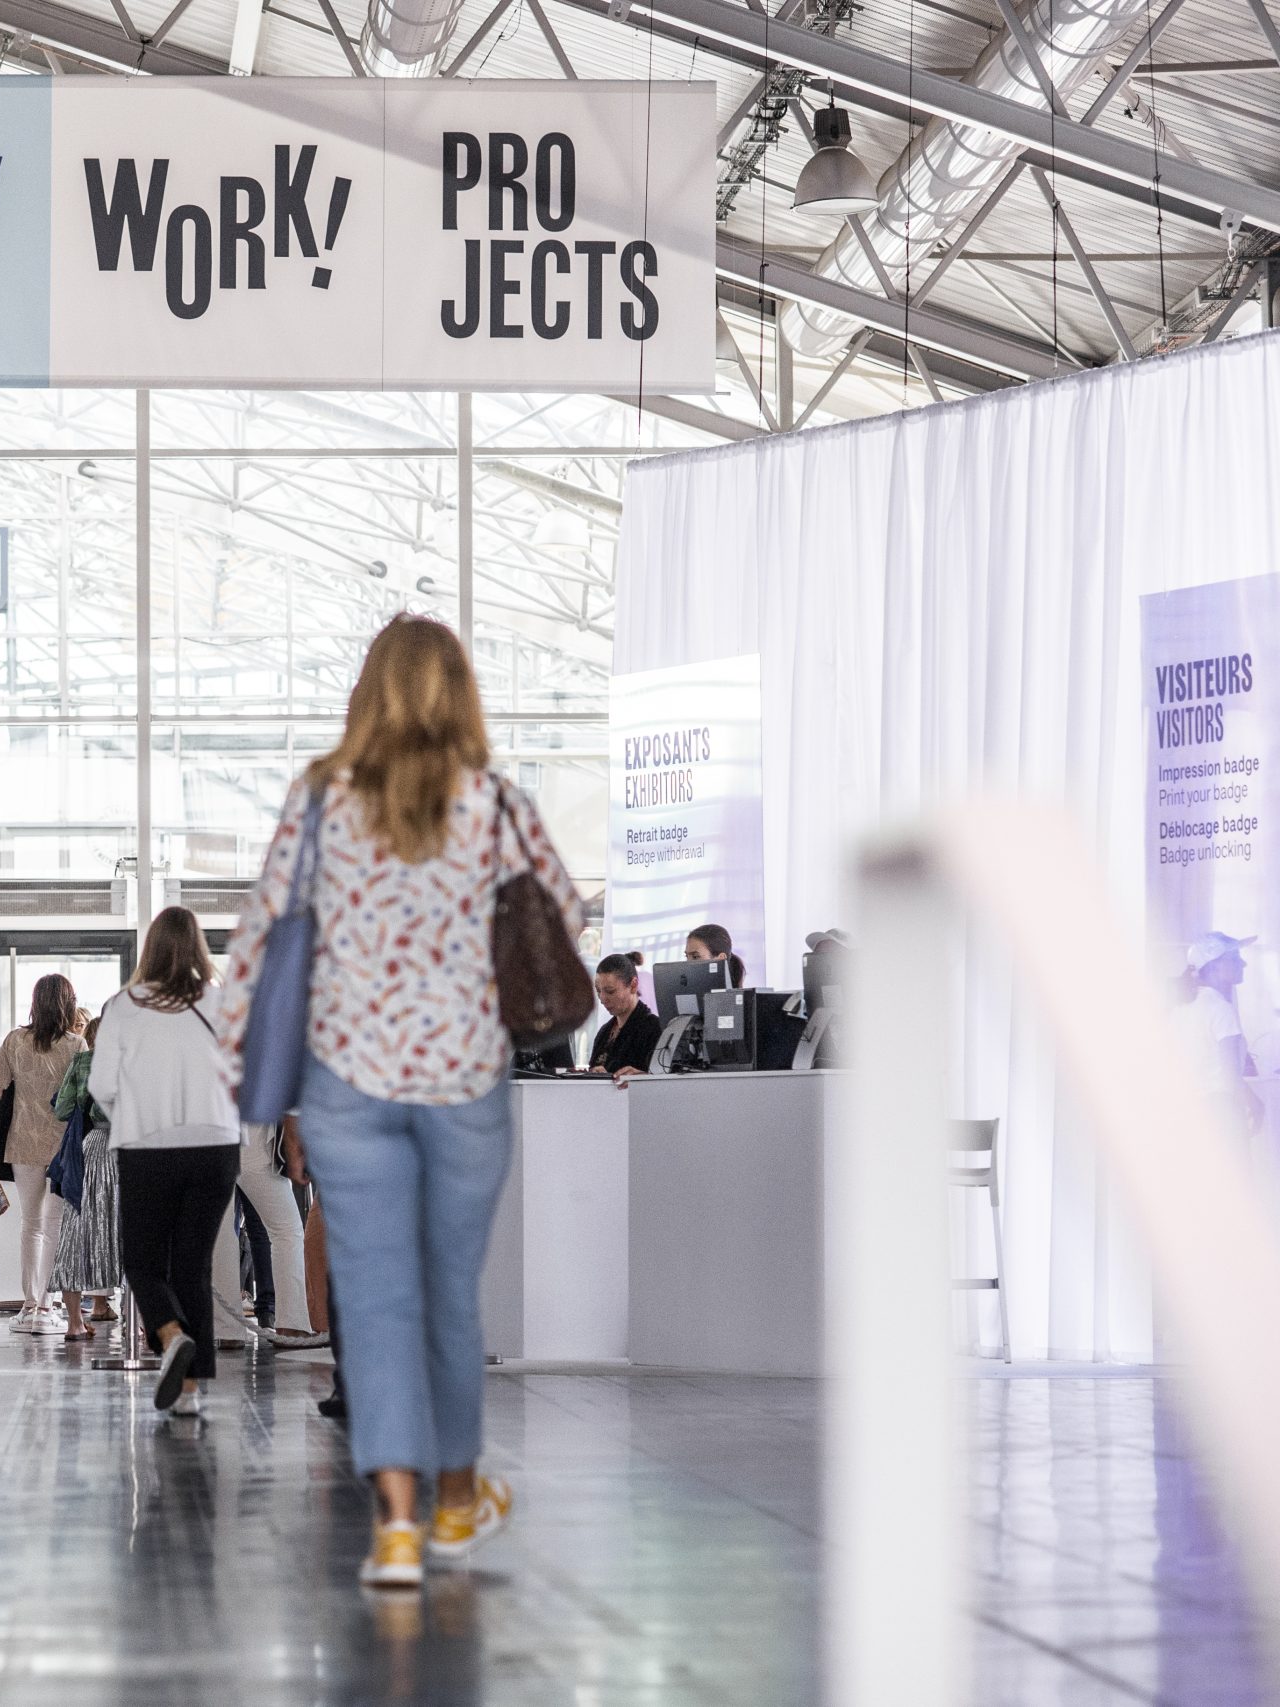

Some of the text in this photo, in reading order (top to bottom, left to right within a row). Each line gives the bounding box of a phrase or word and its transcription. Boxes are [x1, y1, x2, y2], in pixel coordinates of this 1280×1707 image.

[441, 131, 577, 233] PRO
[83, 144, 353, 320] WORK!
[441, 239, 661, 341] JECTS
[1155, 652, 1253, 705] VISITEURS
[1156, 702, 1225, 750] VISITORS
[624, 726, 711, 771] EXPOSANTS
[624, 768, 694, 810] EXHIBITORS
[1158, 755, 1260, 785] Impression badge
[1158, 782, 1249, 809] Print your badge
[626, 824, 689, 844] Retrait badge
[1159, 814, 1259, 841] Déblocage badge
[627, 842, 705, 868] Badge withdrawal
[1159, 841, 1252, 868] Badge unlocking
